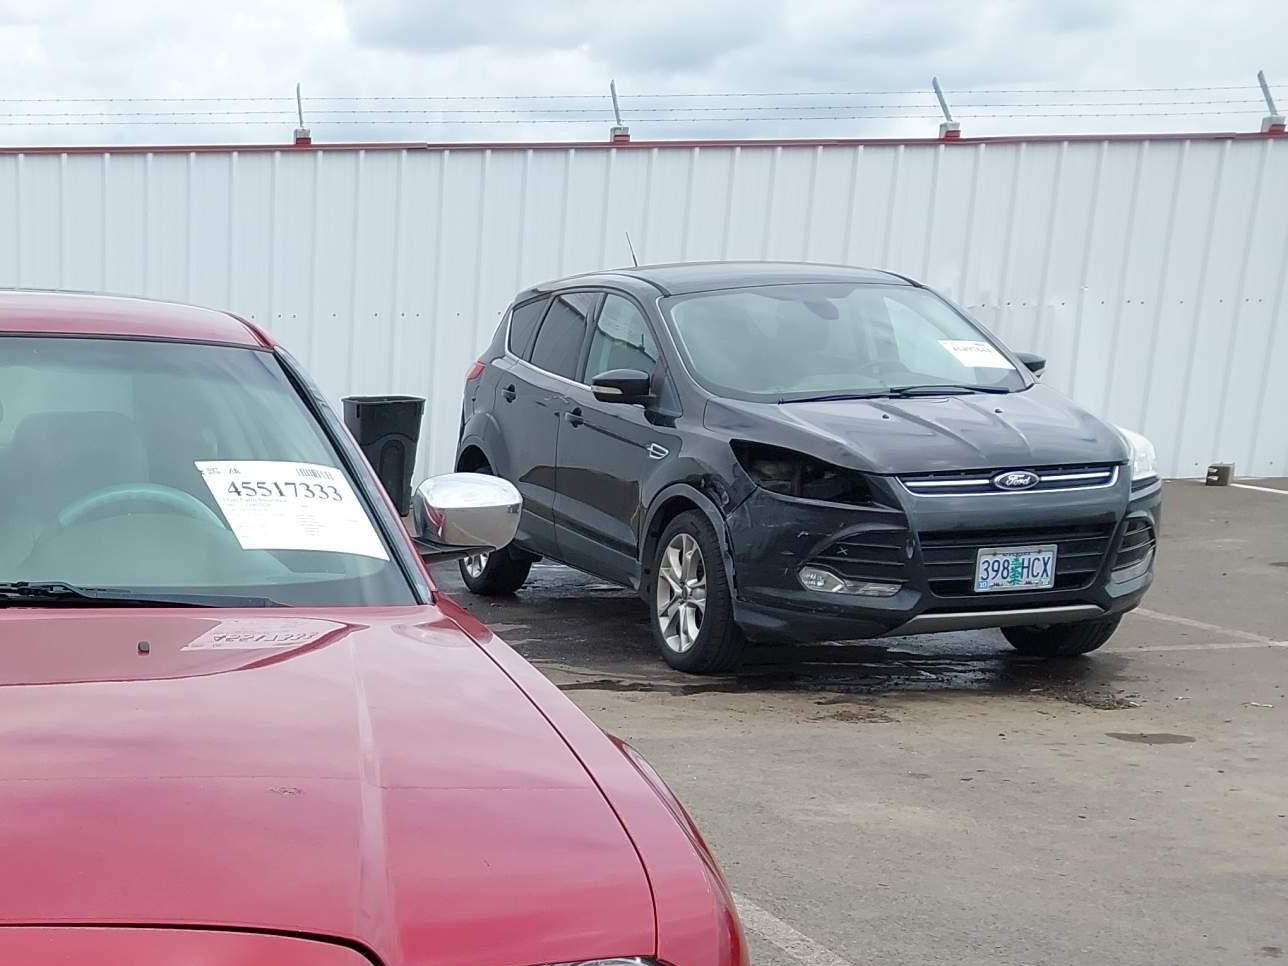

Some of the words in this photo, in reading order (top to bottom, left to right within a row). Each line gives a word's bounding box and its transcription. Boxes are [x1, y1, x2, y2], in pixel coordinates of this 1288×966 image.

[1005, 474, 1031, 486] Ford
[227, 481, 343, 502] 45517333
[980, 558, 1010, 581] 398
[1020, 556, 1051, 579] HCX
